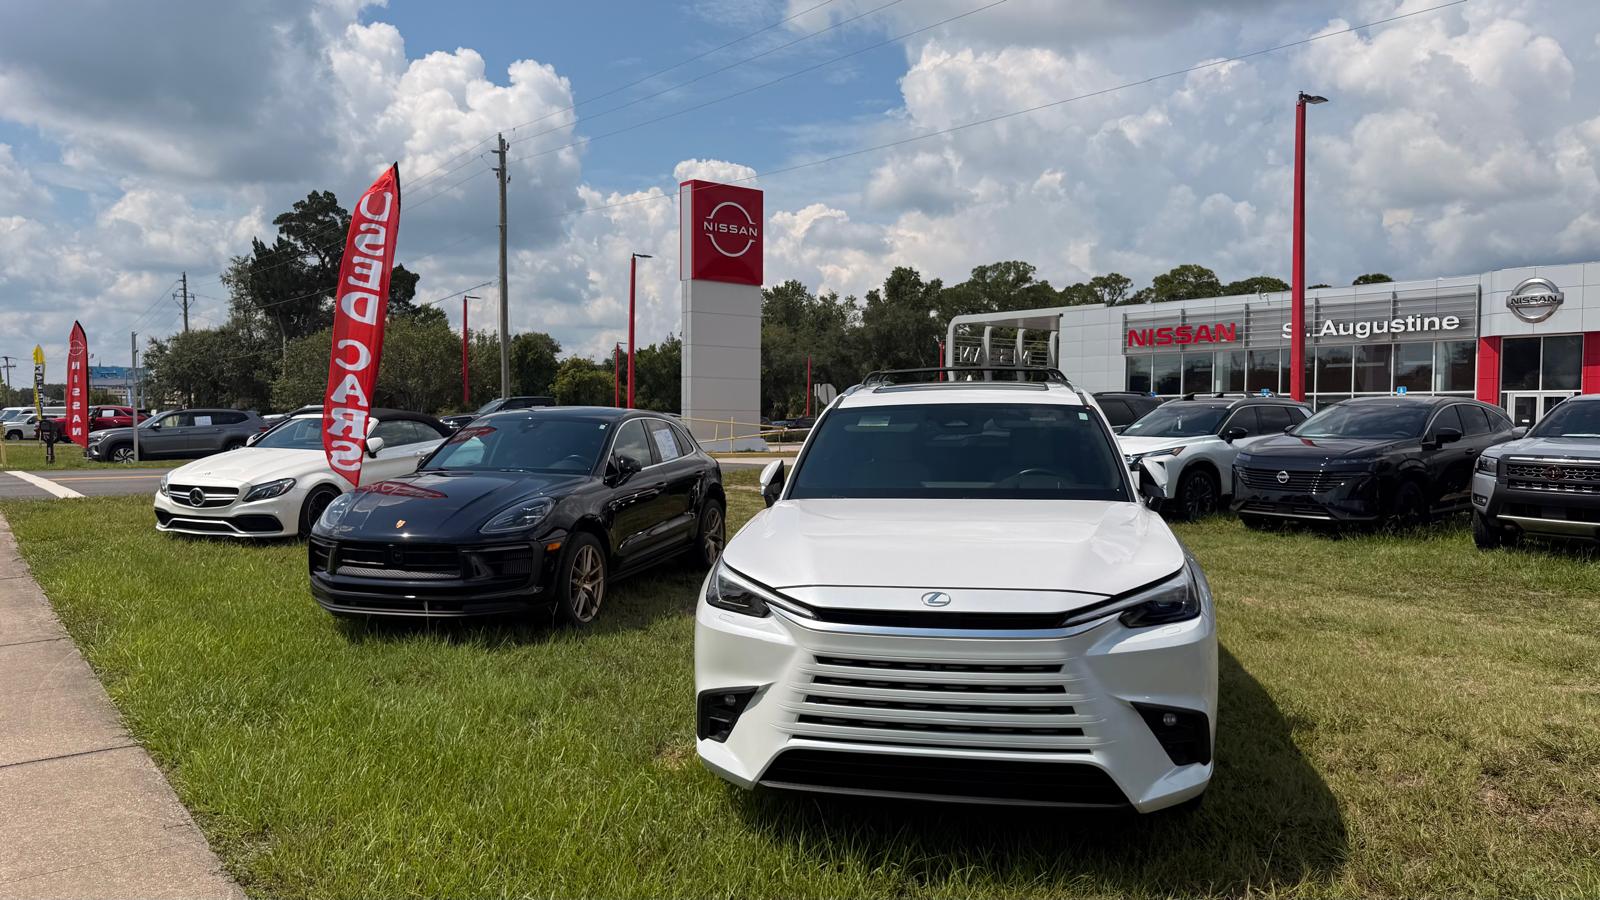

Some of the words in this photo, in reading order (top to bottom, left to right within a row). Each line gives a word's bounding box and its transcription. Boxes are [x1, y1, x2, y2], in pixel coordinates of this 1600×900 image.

[703, 221, 758, 237] NISSAN
[1511, 295, 1557, 304] NISSAN
[1127, 322, 1236, 347] NISSAN
[1282, 322, 1310, 338] S.
[1320, 314, 1460, 338] Augustine
